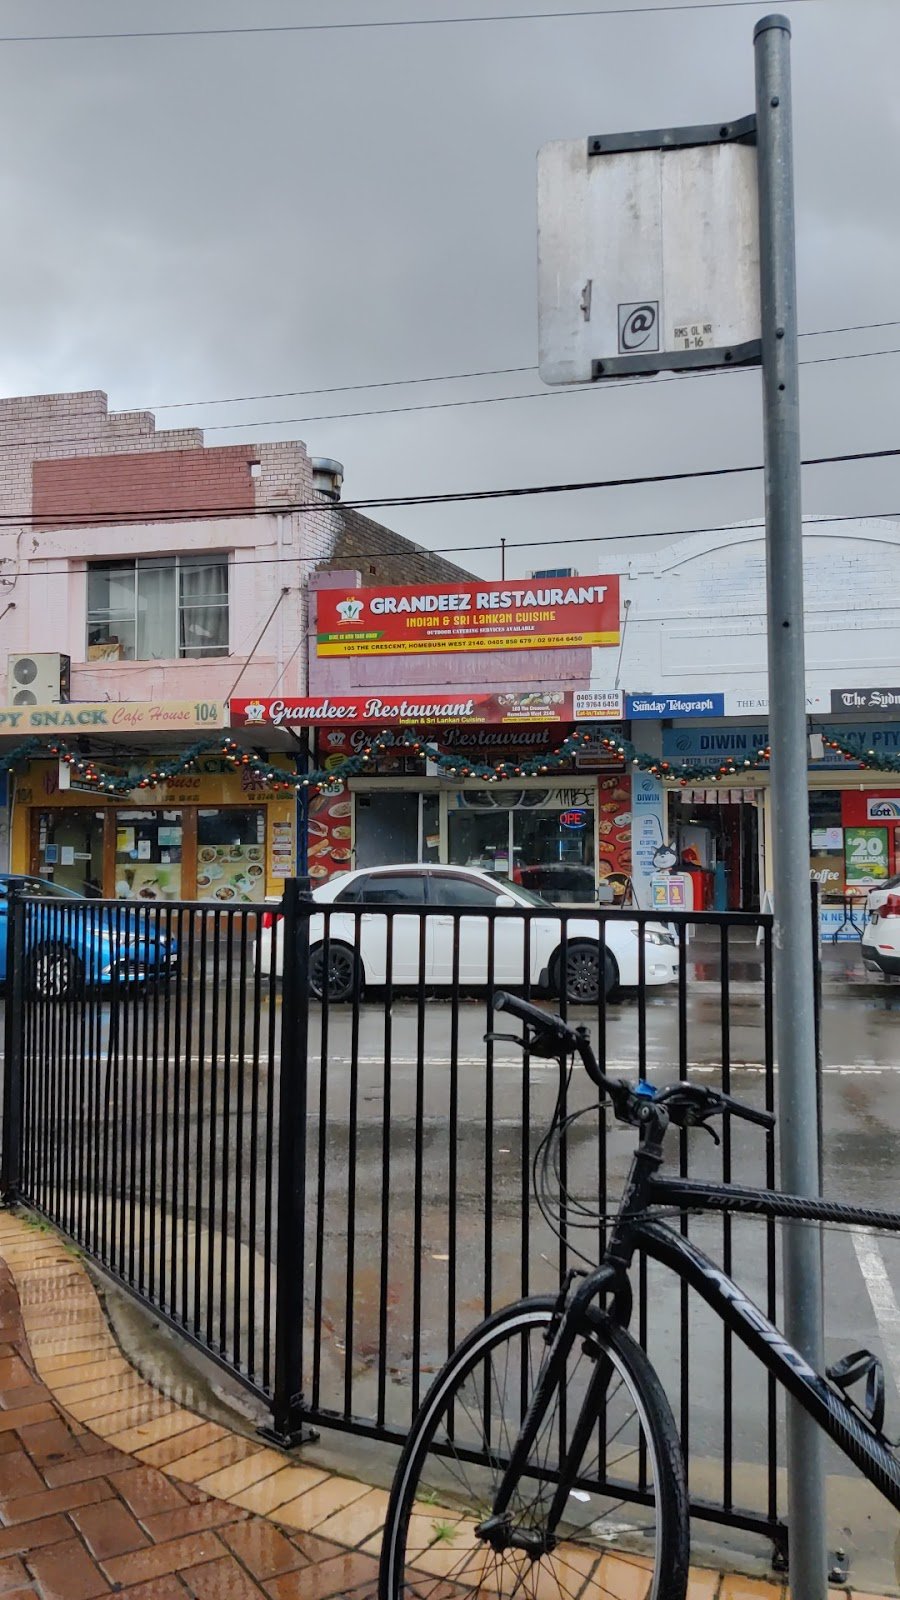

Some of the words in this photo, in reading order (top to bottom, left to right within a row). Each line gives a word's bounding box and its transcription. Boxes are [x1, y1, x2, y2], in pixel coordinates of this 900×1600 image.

[674, 327, 688, 338] RMS
[684, 337, 704, 349] 11-16
[370, 593, 472, 615] GRANDEEZ
[476, 586, 608, 609] RESTAURANT
[453, 614, 470, 626] SRI
[515, 610, 556, 623] CUISINE
[632, 700, 666, 713] Sunday
[666, 698, 713, 713] Telegraph
[737, 700, 754, 708] THE
[841, 692, 867, 708] The
[31, 709, 107, 726] SNACK
[112, 707, 143, 726] Cafe
[149, 706, 191, 720] House
[194, 703, 218, 721] 104
[269, 700, 358, 725] Grandeez
[363, 698, 474, 717] Restaurant
[436, 716, 460, 724] Lankan
[700, 734, 747, 750] DIWIN
[637, 793, 660, 802] DIWIN
[870, 808, 891, 817] Lott
[809, 868, 840, 883] Coffee
